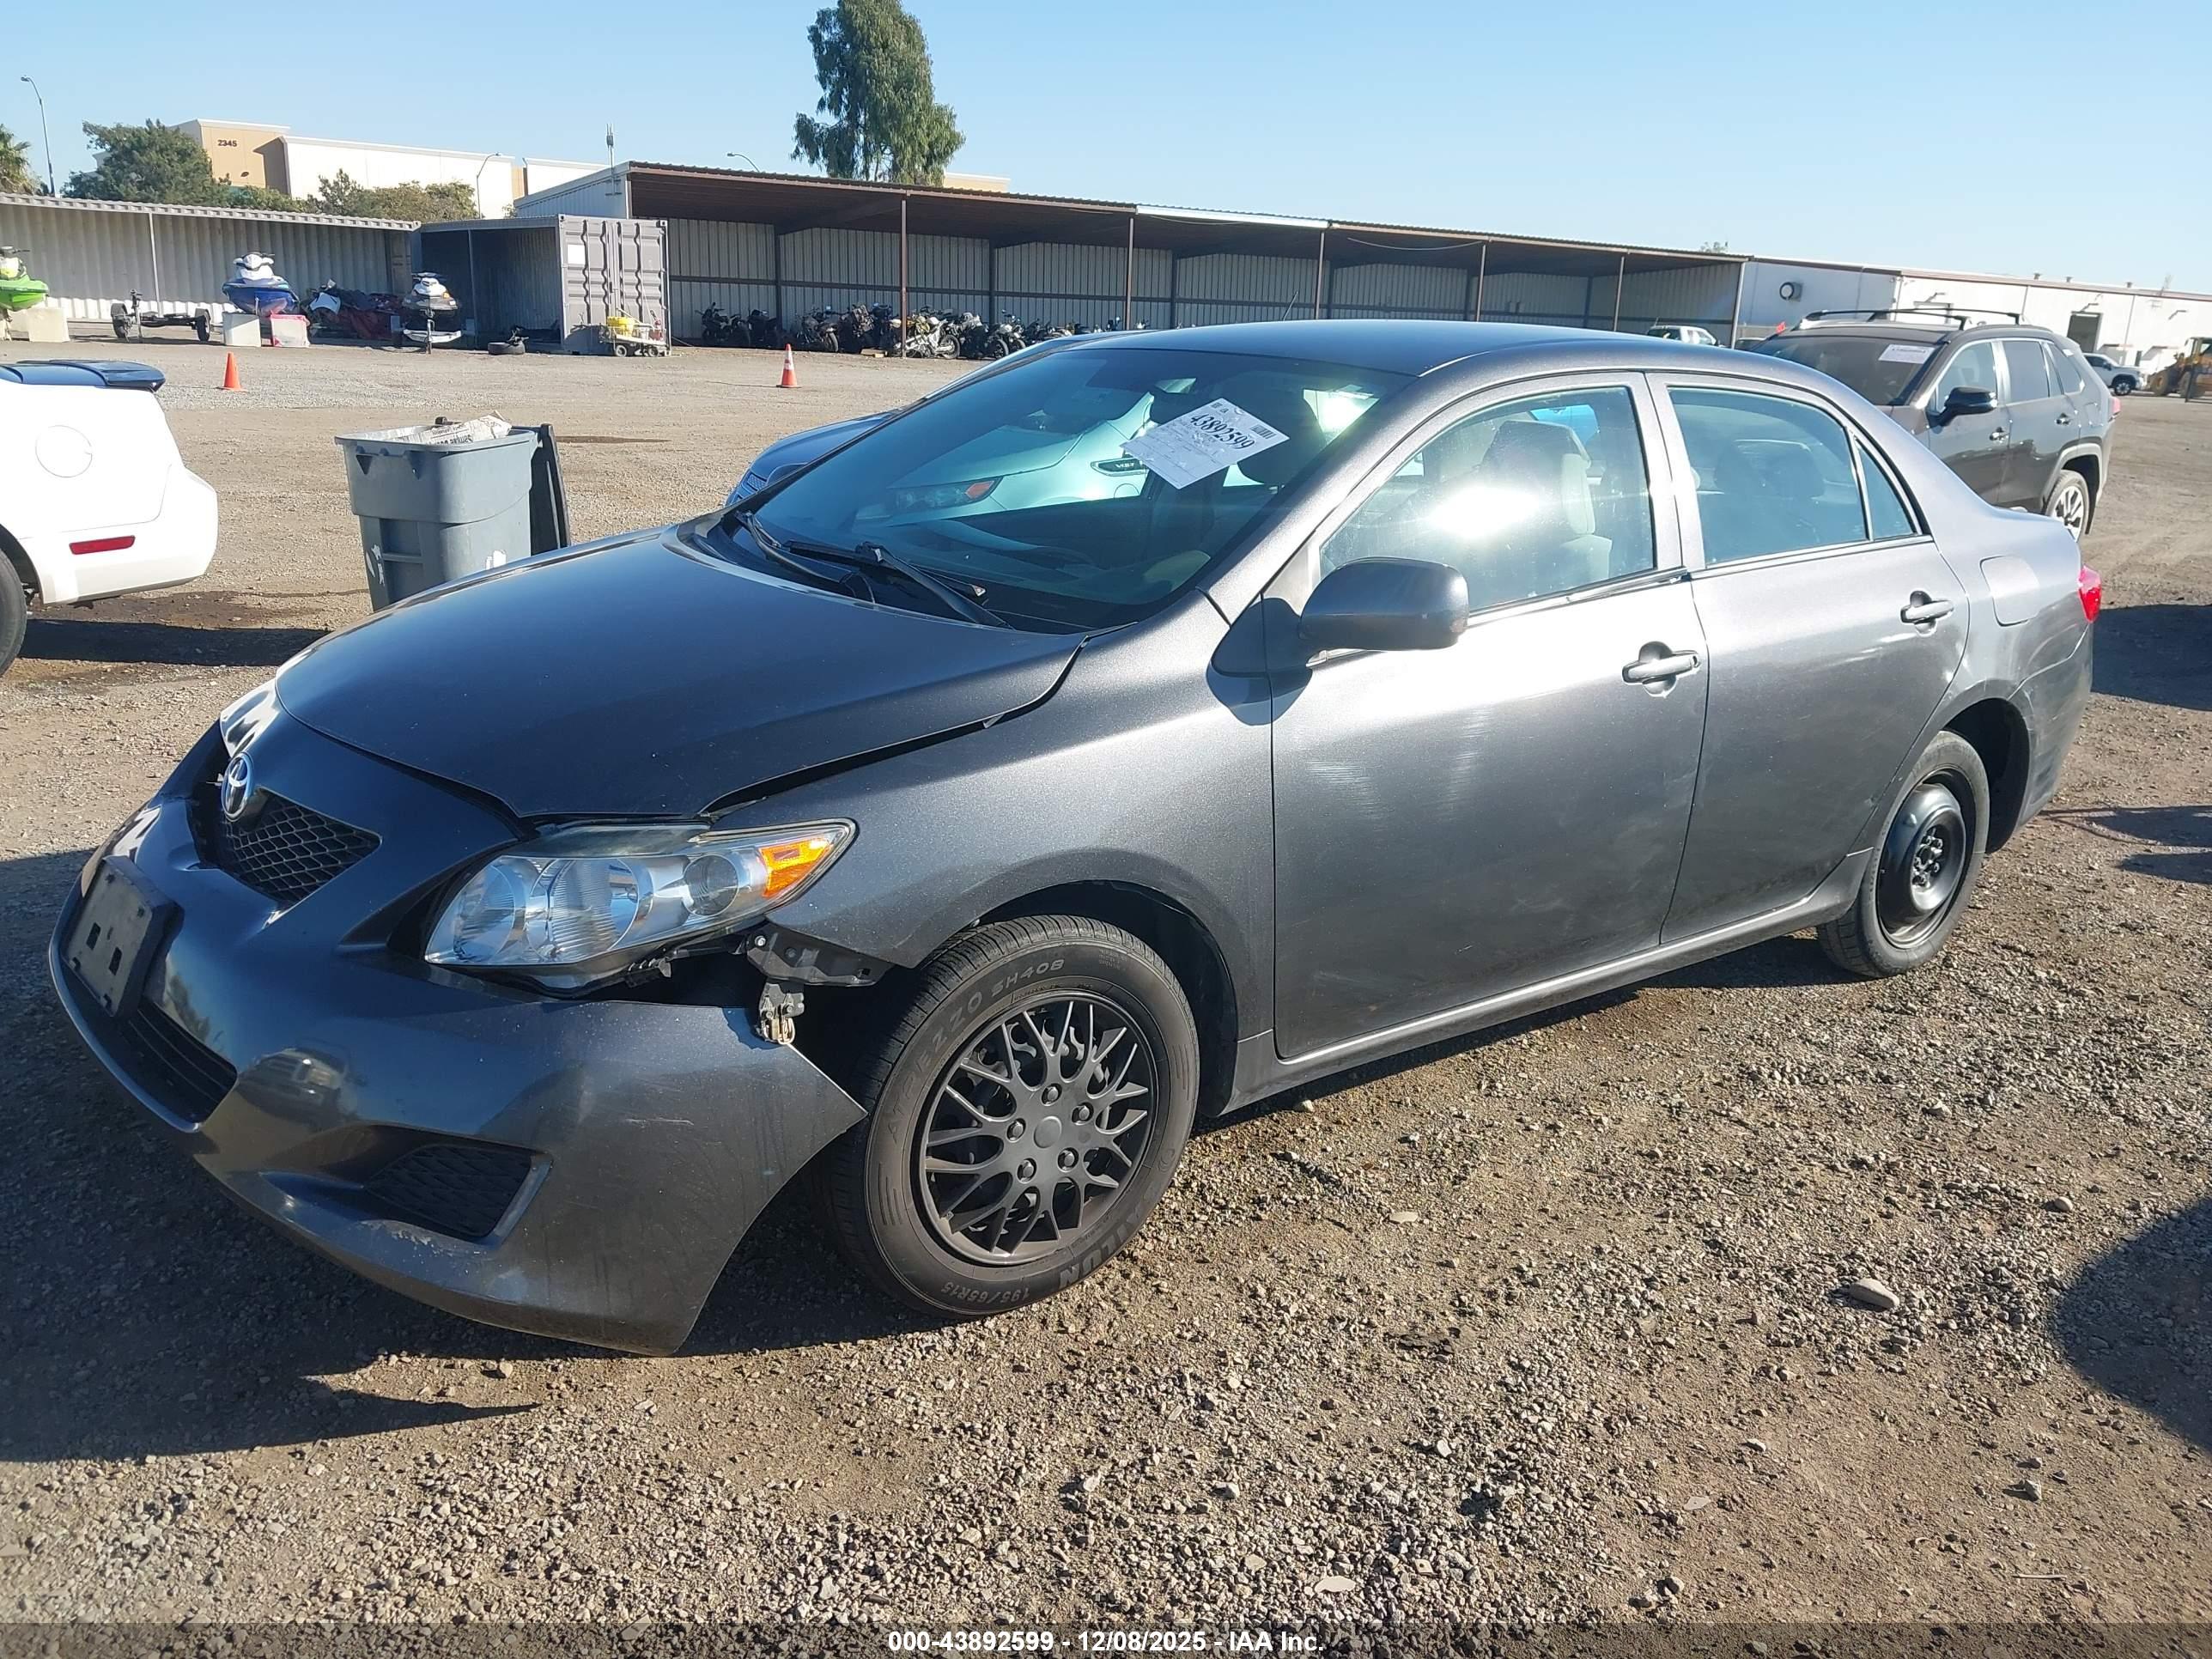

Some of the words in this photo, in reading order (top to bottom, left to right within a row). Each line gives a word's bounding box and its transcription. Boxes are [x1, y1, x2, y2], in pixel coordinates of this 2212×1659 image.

[1190, 413, 1255, 449] 43892599
[990, 958, 1066, 997] SH408
[941, 1281, 1030, 1304] 195/65R15
